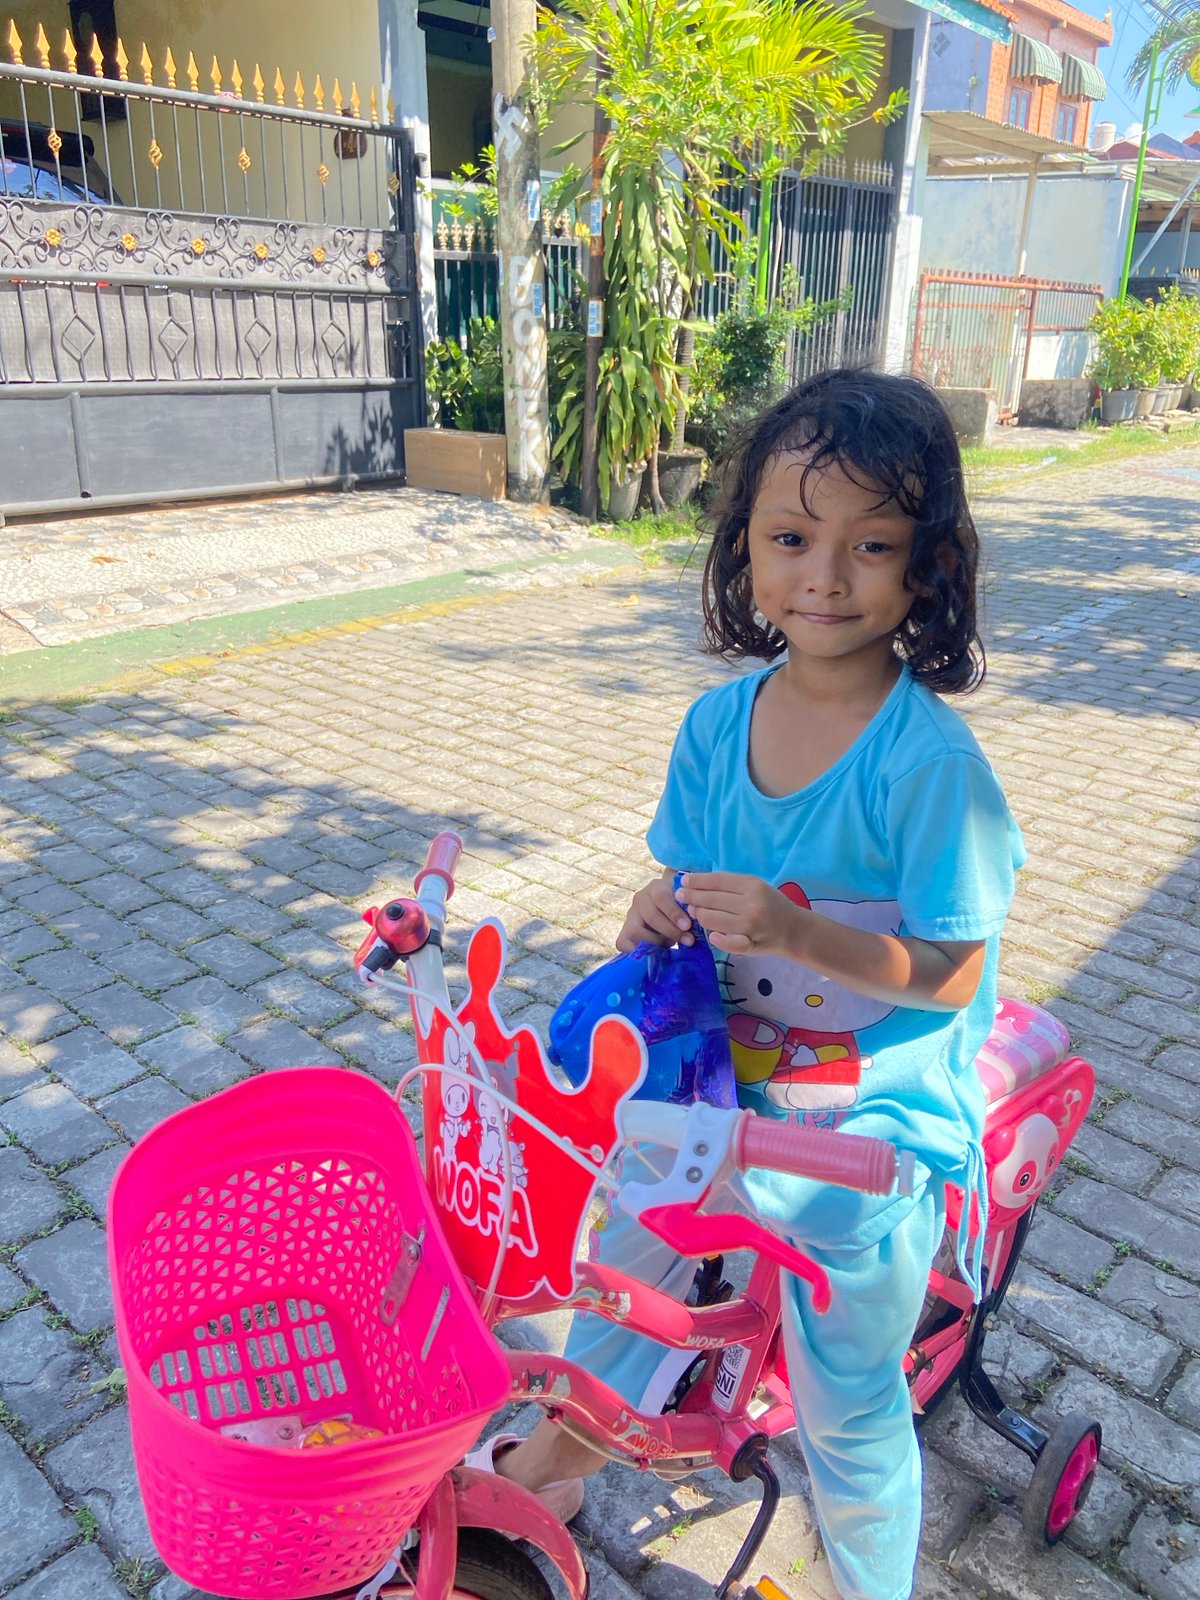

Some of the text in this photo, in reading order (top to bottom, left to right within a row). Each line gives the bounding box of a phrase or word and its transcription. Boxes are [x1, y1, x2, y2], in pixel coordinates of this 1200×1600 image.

[433, 1145, 539, 1258] WOFA
[685, 1334, 726, 1349] WOFA
[715, 1366, 736, 1395] SNI
